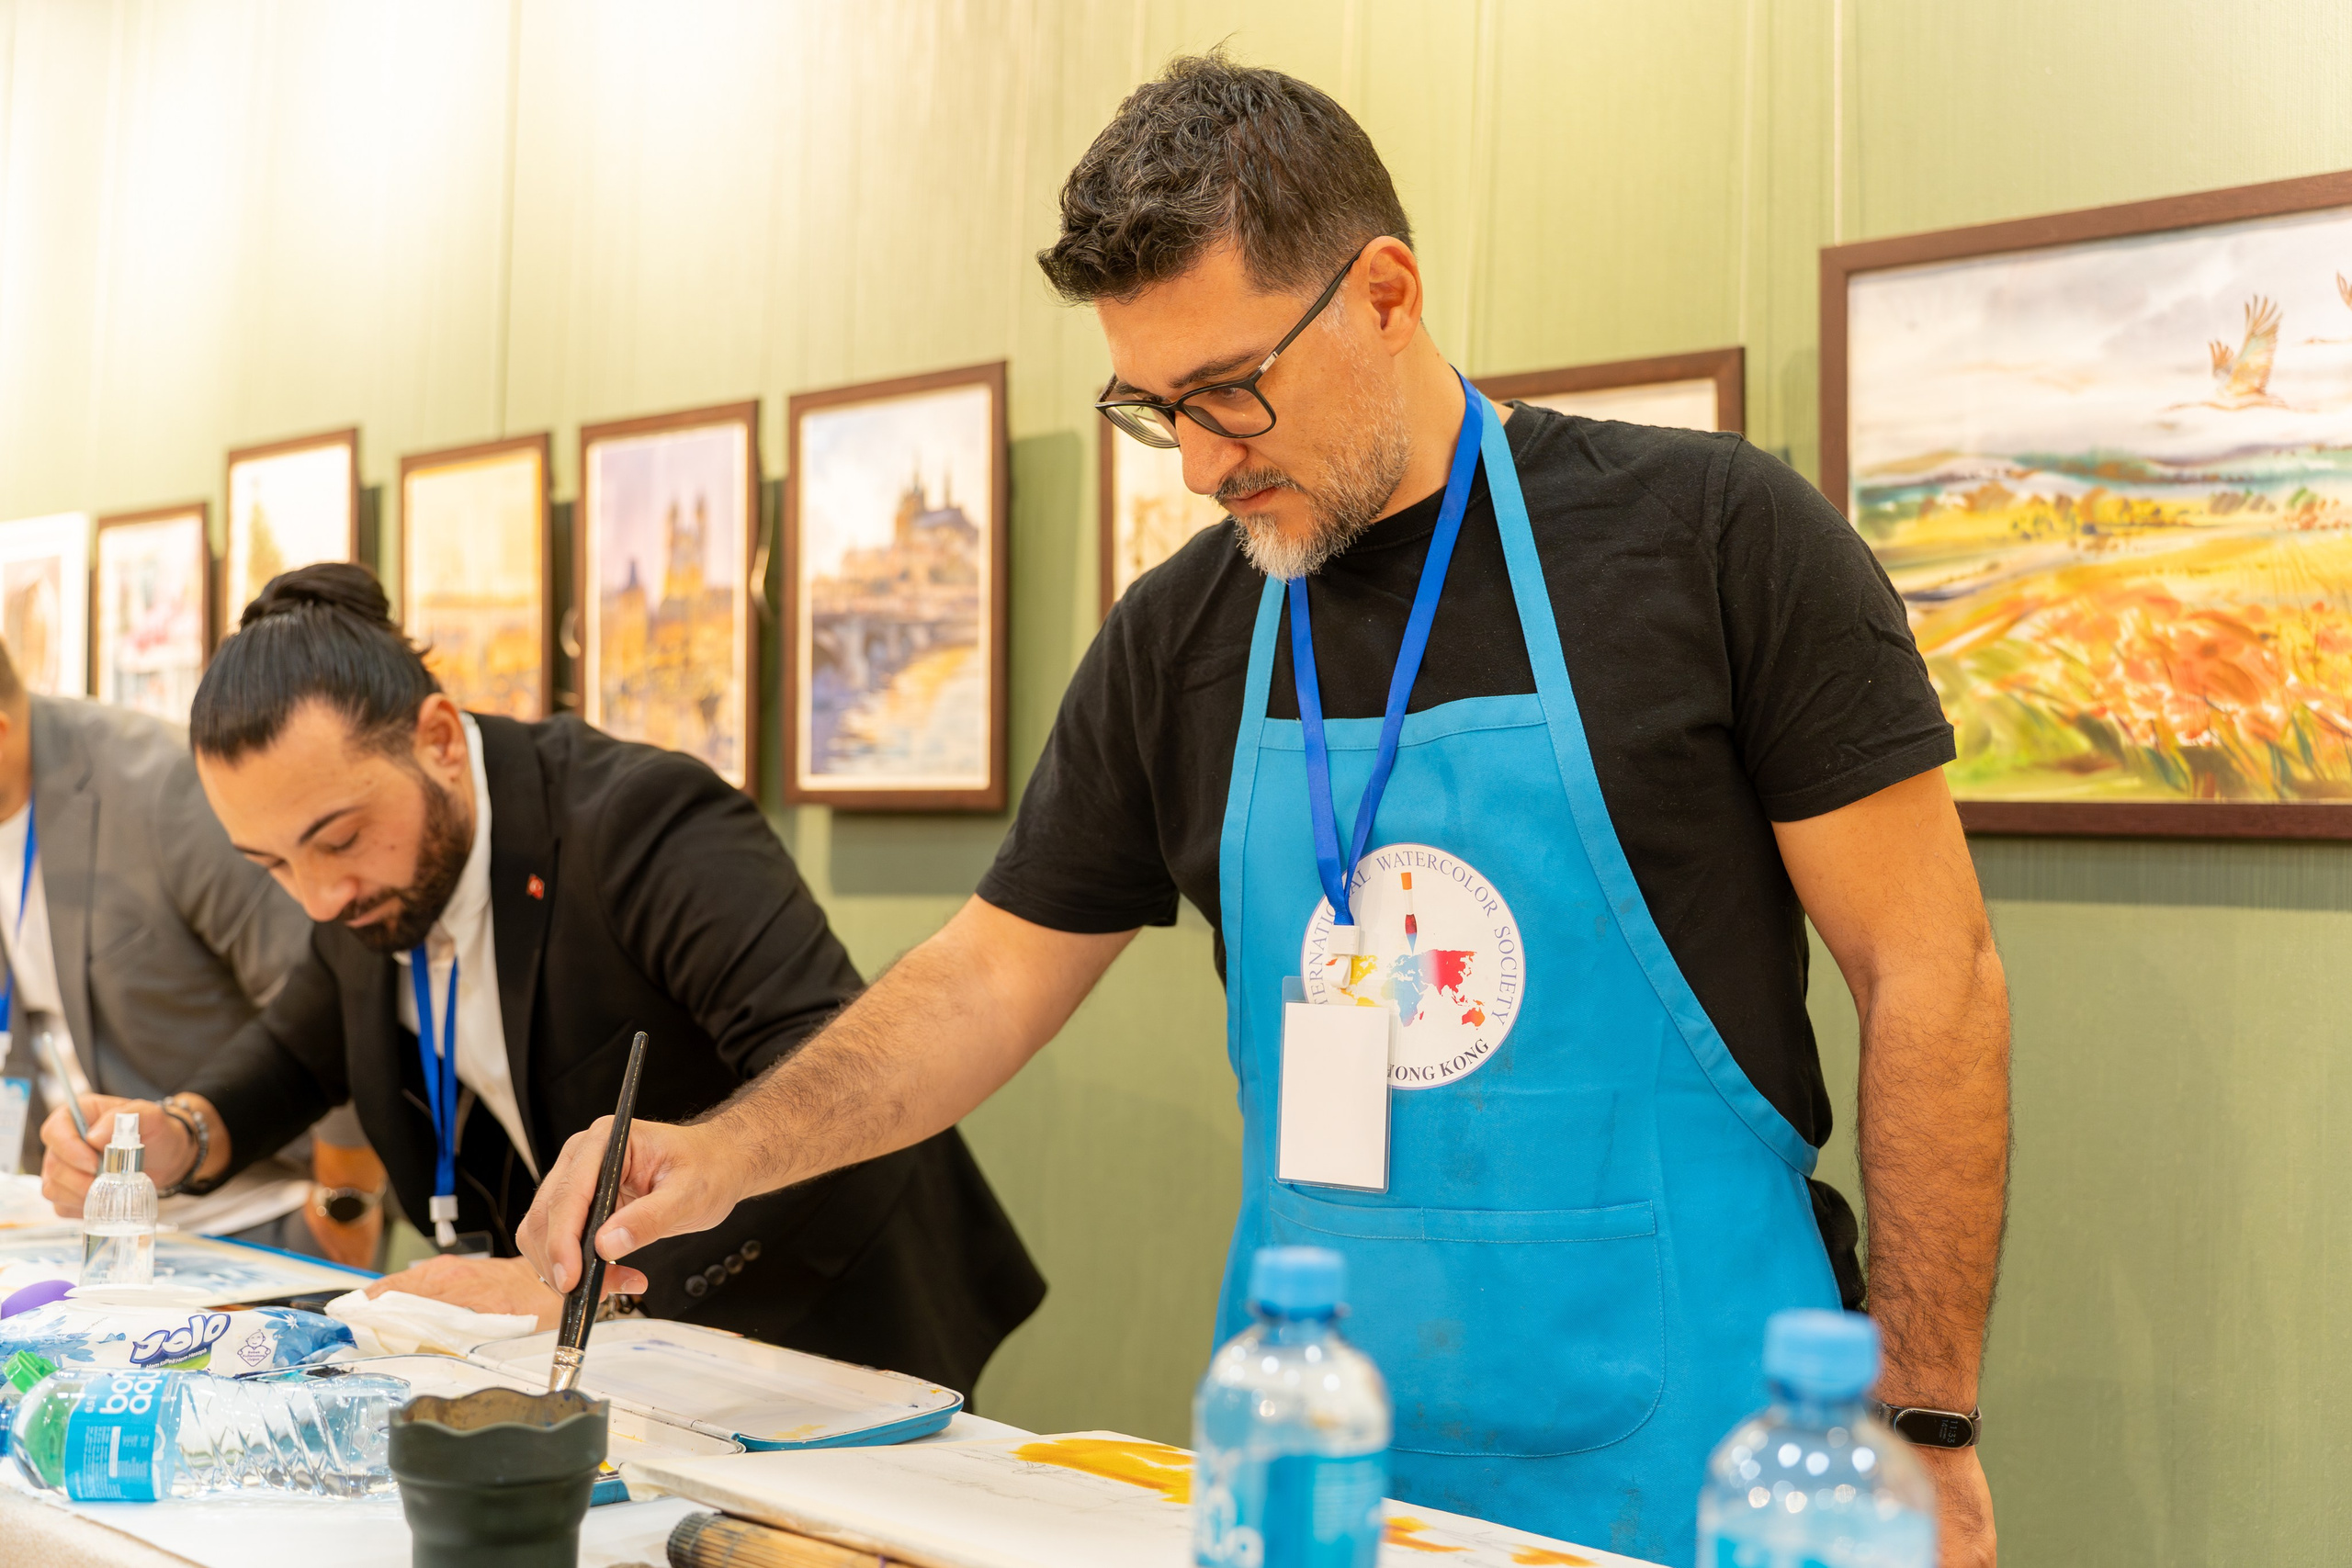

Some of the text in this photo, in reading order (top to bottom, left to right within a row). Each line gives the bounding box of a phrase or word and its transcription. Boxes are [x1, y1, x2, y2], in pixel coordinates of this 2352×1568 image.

[1376, 851, 1498, 918] WATERCOLOR
[1491, 926, 1517, 1025] SOCIETY
[1439, 1038, 1489, 1078] KONG
[1947, 1420, 1959, 1444] 11:33
